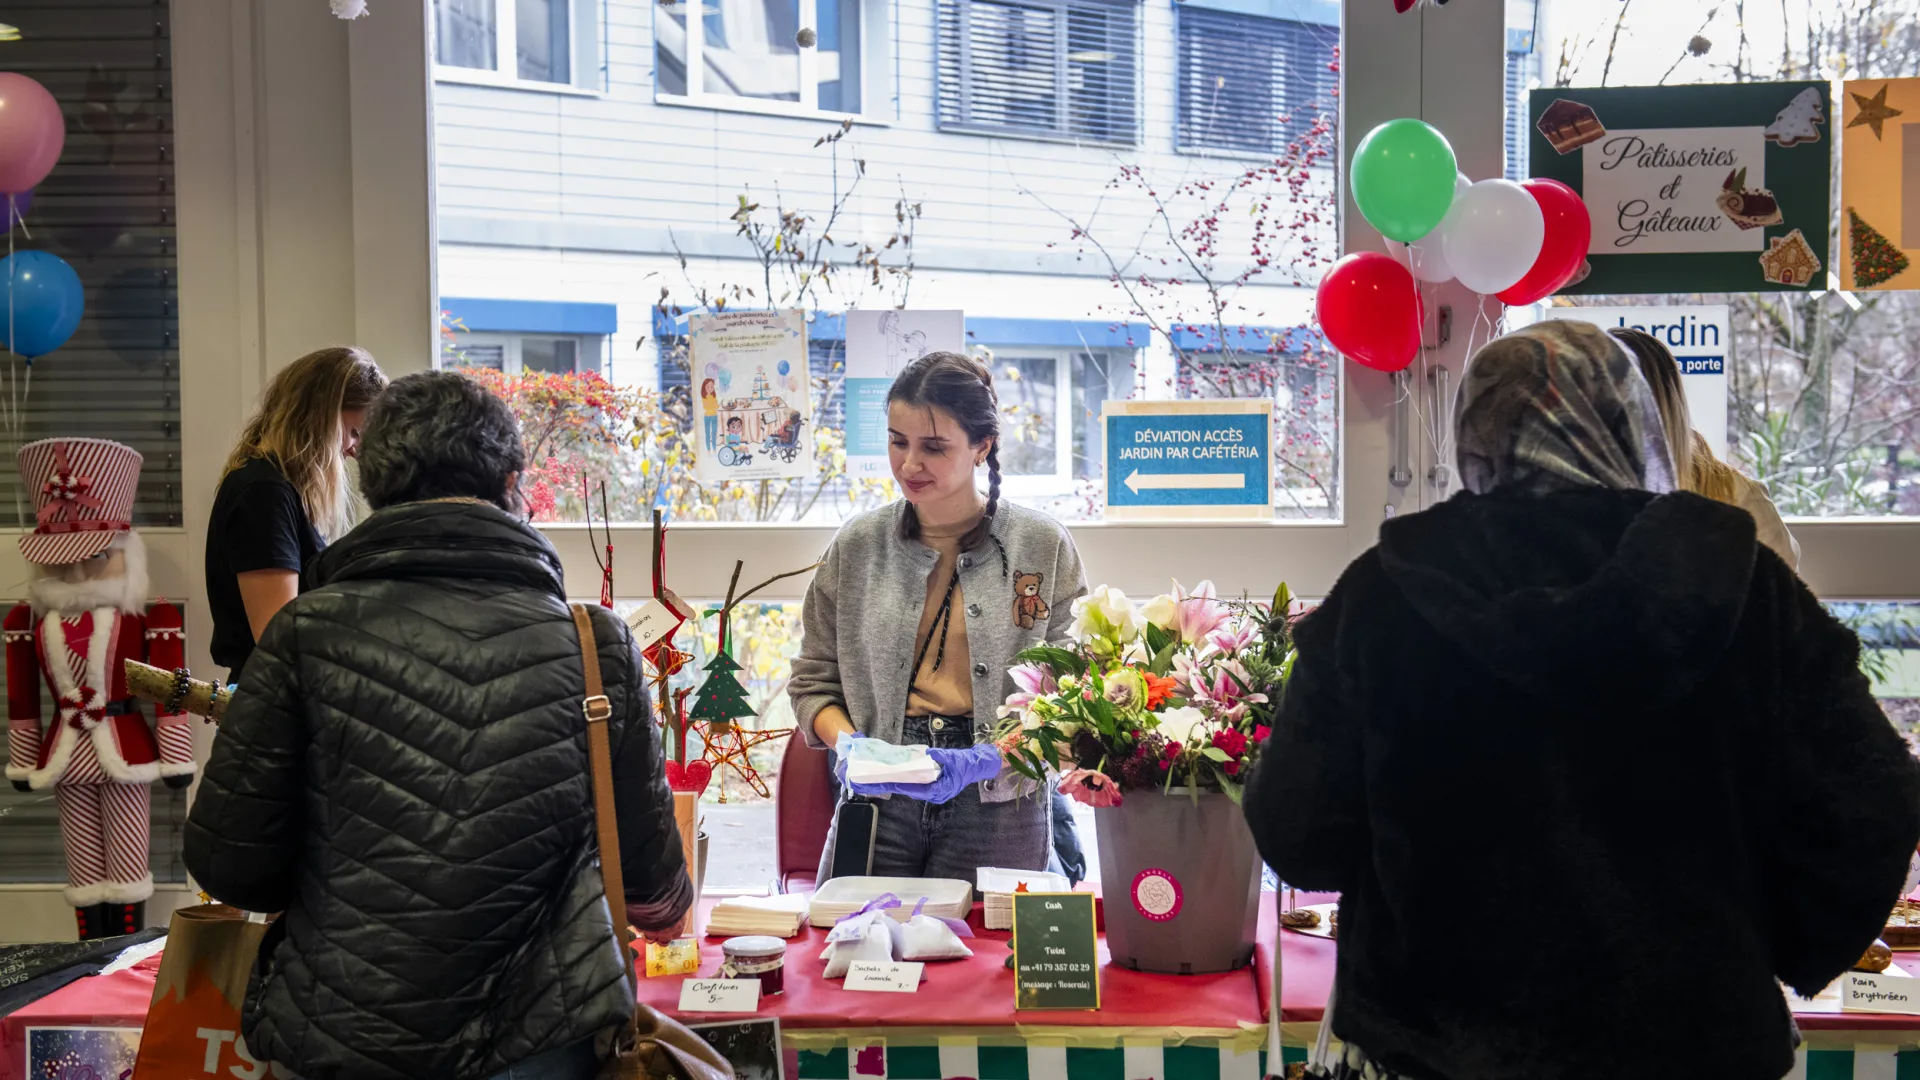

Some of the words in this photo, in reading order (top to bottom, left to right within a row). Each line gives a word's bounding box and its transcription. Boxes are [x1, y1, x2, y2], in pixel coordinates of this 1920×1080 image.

[1600, 135, 1738, 170] Pâtisseries
[1658, 174, 1682, 200] et
[1614, 199, 1724, 247] Gâteaux
[1687, 360, 1721, 373] porte
[1135, 428, 1200, 443] DÉVIATION
[1204, 427, 1243, 442] ACCÈS
[1119, 447, 1162, 459] JARDIN
[1166, 446, 1189, 459] PAR
[1192, 443, 1259, 459] CAFÉTÉRIA
[1044, 901, 1063, 910] Cash
[1044, 946, 1066, 955] Twint
[854, 964, 881, 972] Sachets
[890, 965, 900, 973] de
[1044, 963, 1053, 972] 79
[1054, 963, 1068, 972] 357
[1069, 963, 1079, 972] 02
[1080, 963, 1090, 972] 29
[692, 982, 739, 994] Confitures
[1852, 977, 1877, 988] Pain
[1852, 990, 1908, 1003] Erythréen
[196, 1027, 297, 1080] TS
